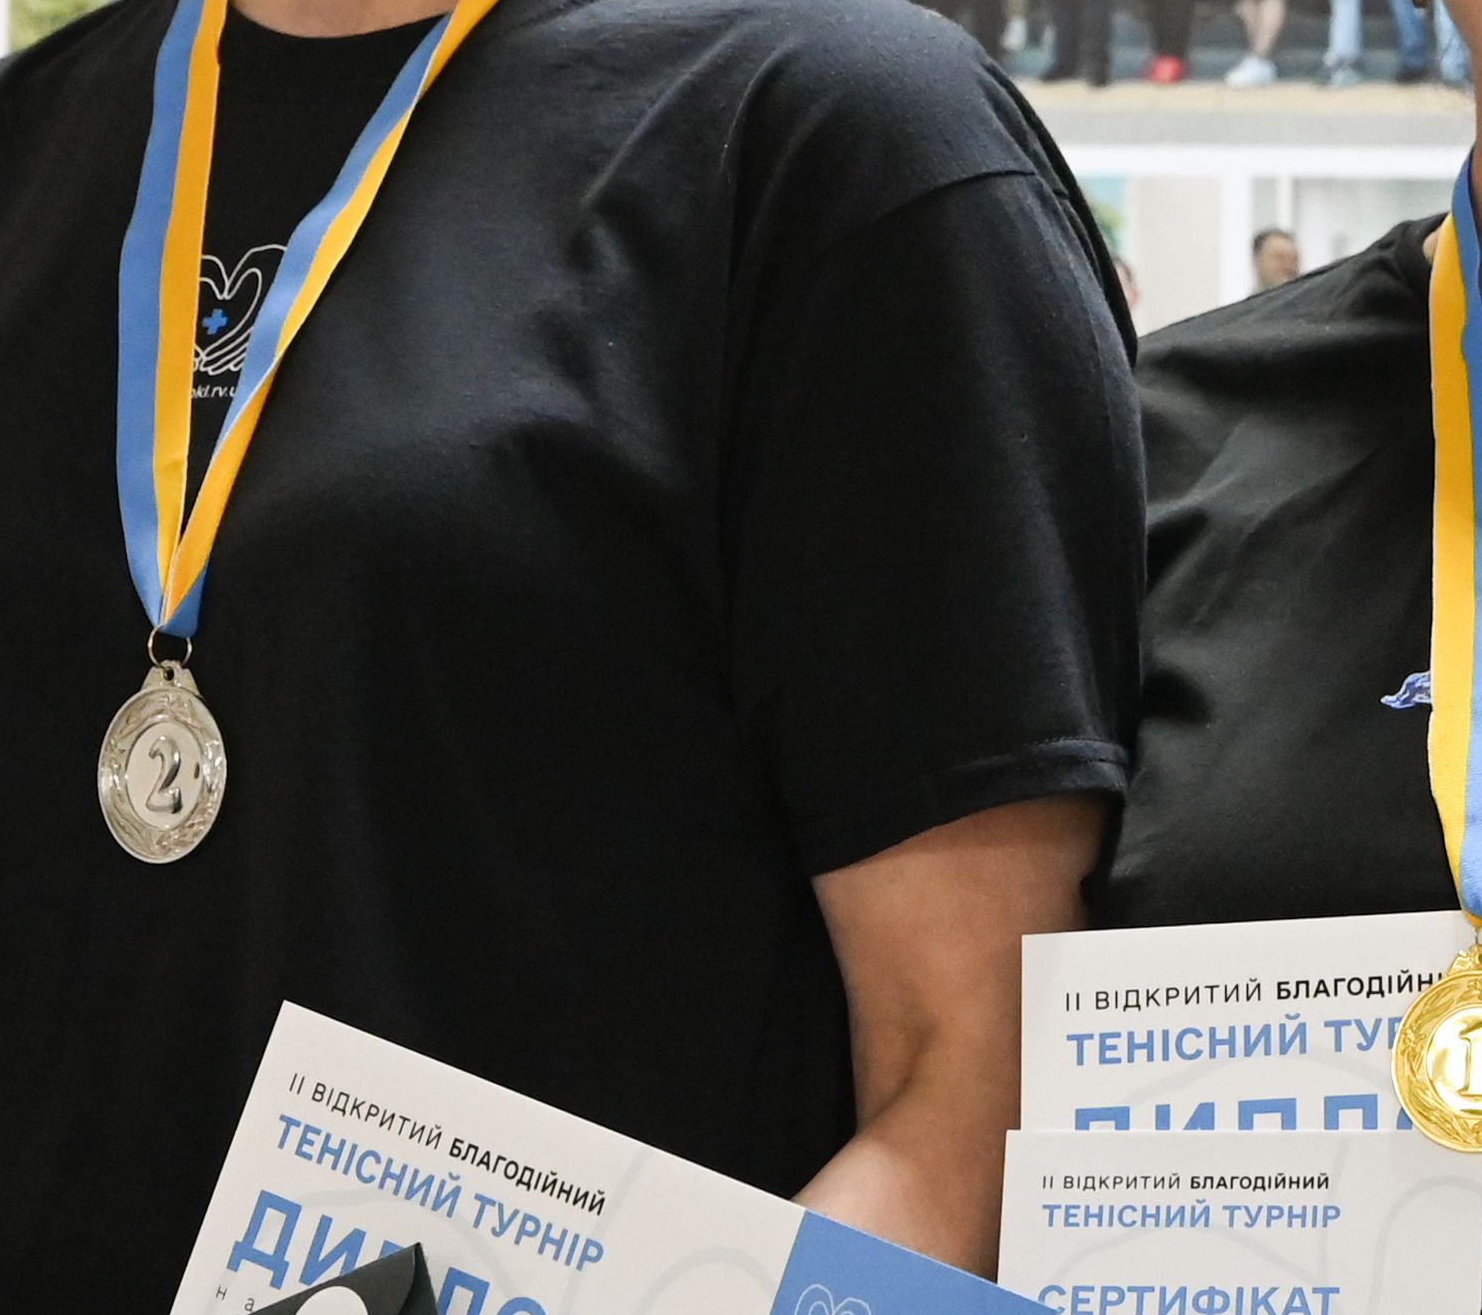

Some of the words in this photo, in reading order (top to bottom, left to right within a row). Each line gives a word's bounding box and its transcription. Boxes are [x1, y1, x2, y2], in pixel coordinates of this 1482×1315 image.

[146, 736, 183, 814] 2
[1095, 979, 1263, 1012] ВІДКРИТИЙ
[1277, 969, 1444, 1000] БЛАГОДІЙН
[1067, 1013, 1308, 1066] ТЕНІСНИЙ
[312, 1083, 443, 1150] ВІДКРИТИЙ
[449, 1138, 606, 1216] БЛАГОДІЙНИЙ
[278, 1114, 462, 1218] ТЕНІСНИЙ
[472, 1193, 604, 1272] ТУРНІР
[1063, 1173, 1181, 1191] ВІДКРИТИЙ
[1190, 1173, 1330, 1192] БЛАГОДІЙНИЙ
[1042, 1198, 1210, 1228] ТЕНІСНИЙ
[1222, 1204, 1341, 1228] ТУРНІР
